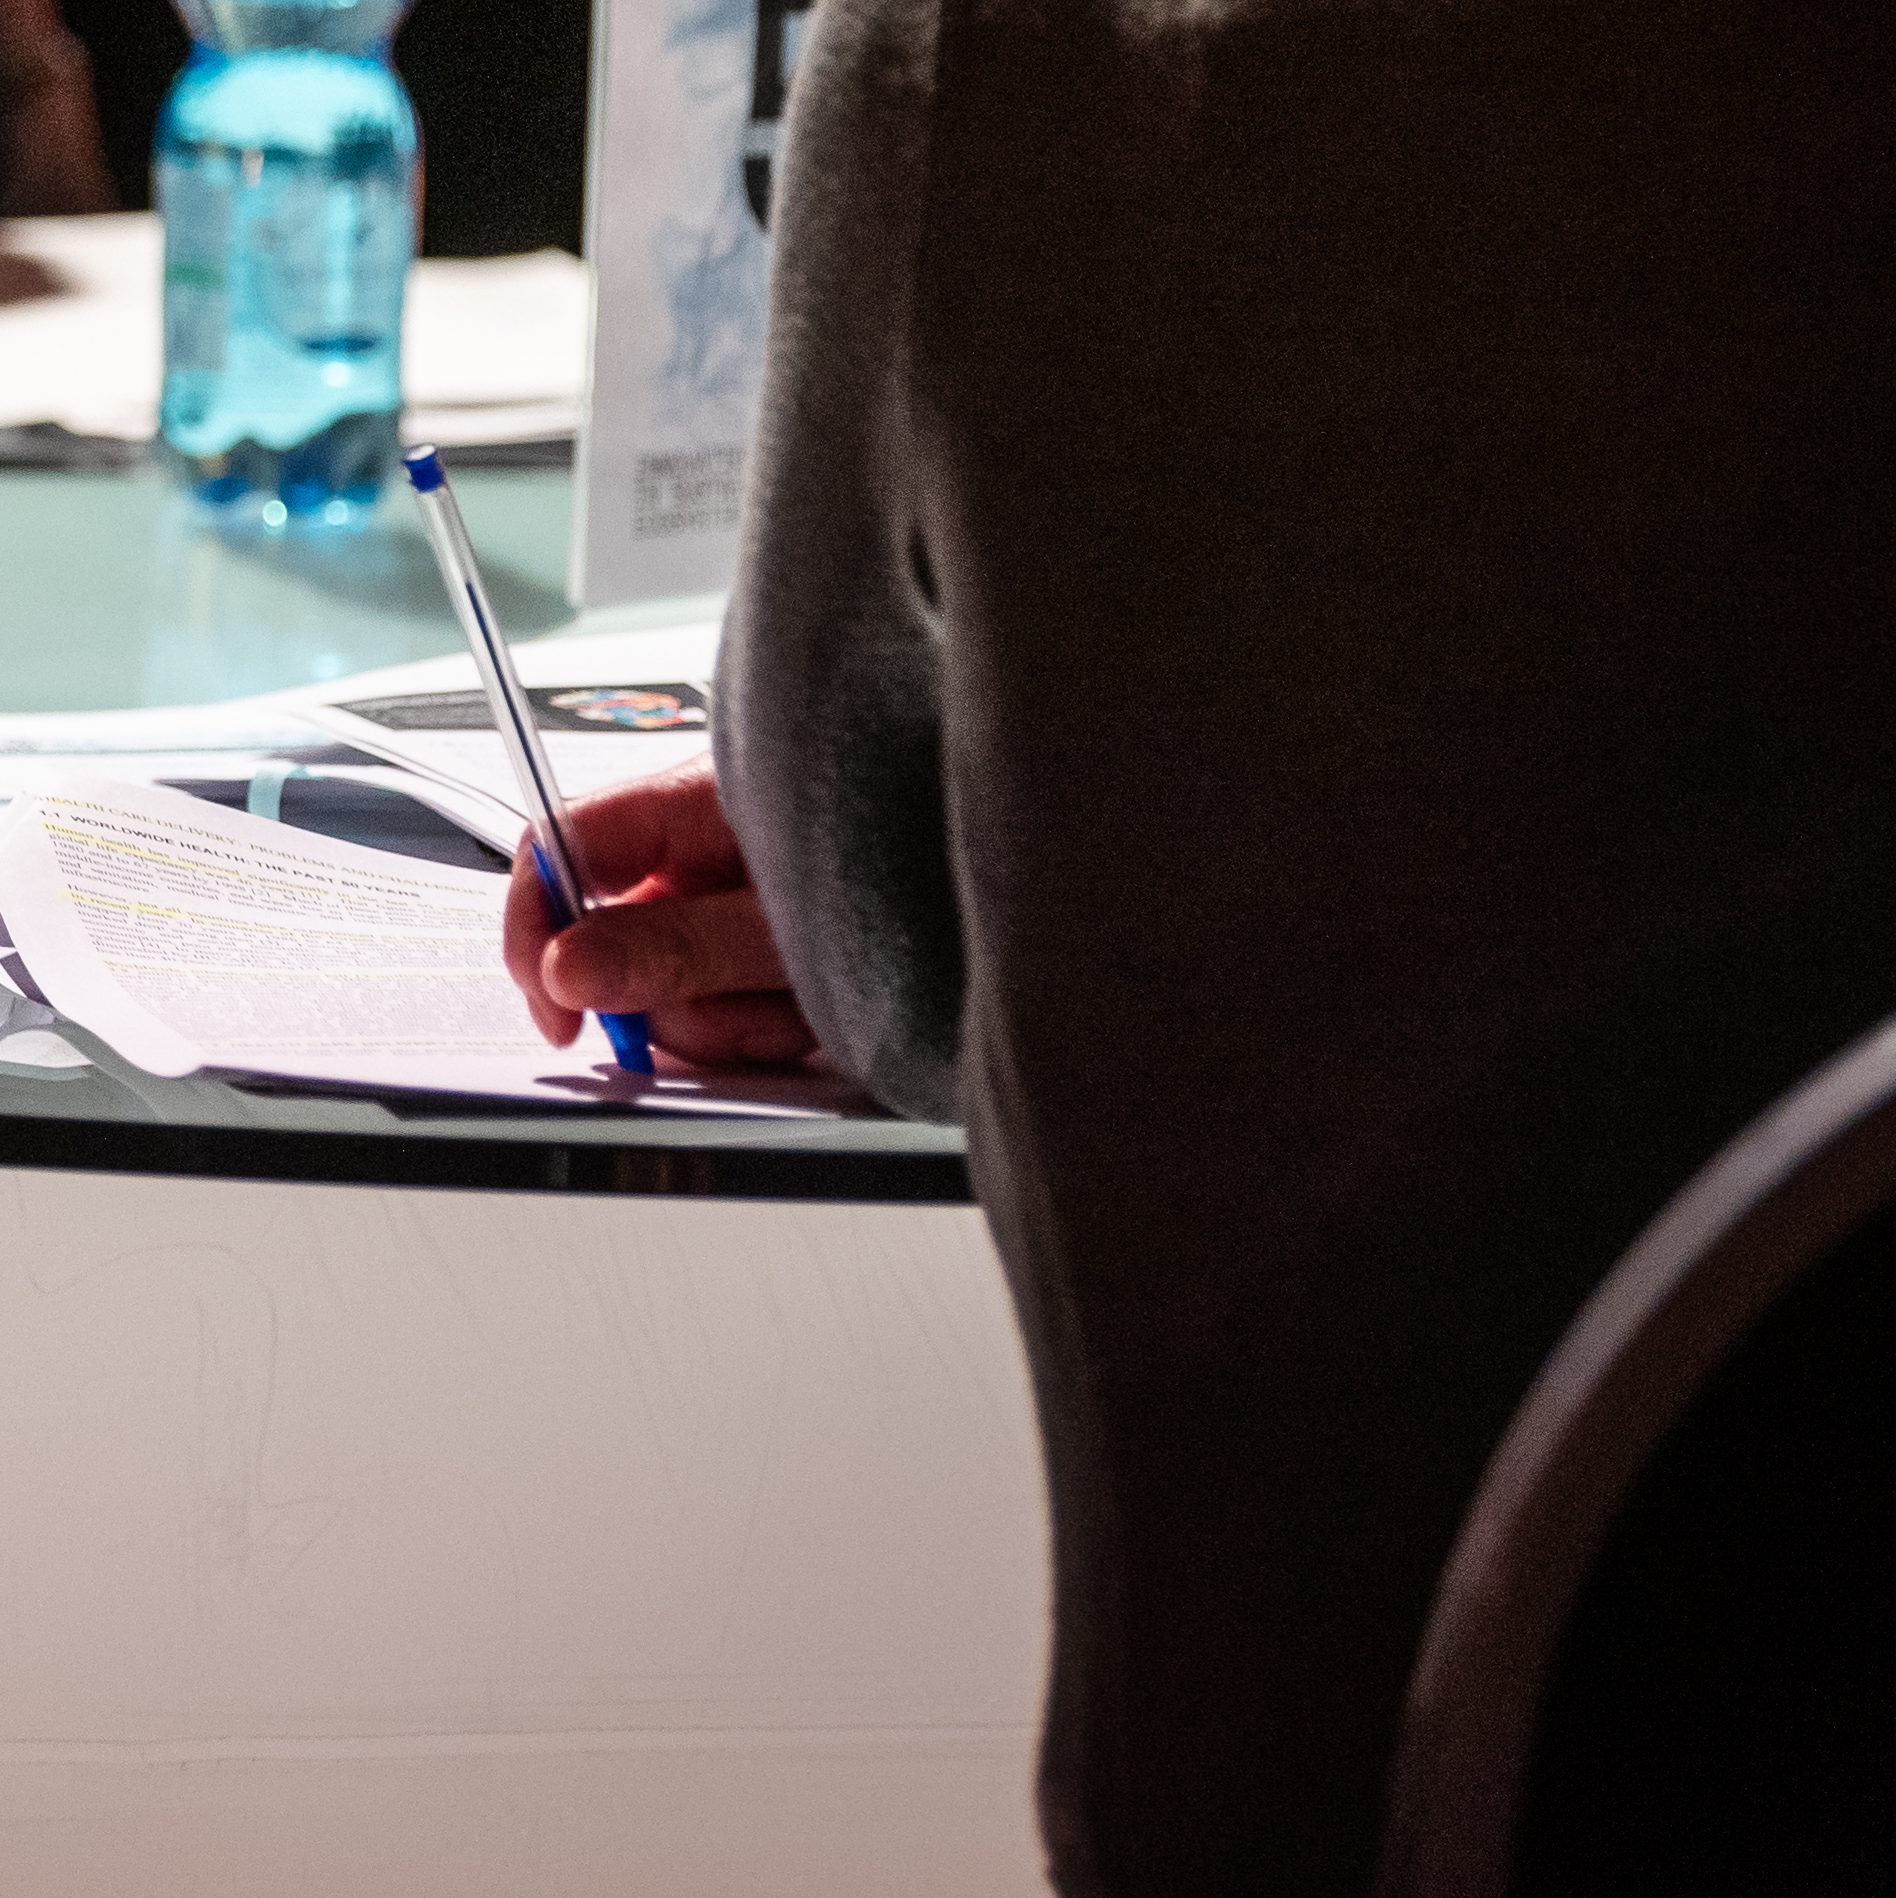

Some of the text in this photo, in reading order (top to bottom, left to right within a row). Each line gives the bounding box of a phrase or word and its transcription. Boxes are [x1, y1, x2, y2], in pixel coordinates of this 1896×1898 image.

[46, 796, 105, 812] HEALTH
[109, 808, 152, 822] CARE
[70, 814, 176, 847] WORLDWIDE
[254, 859, 289, 874] THE
[292, 869, 333, 884] PAST
[363, 883, 421, 898] YEARS
[101, 835, 141, 852] health
